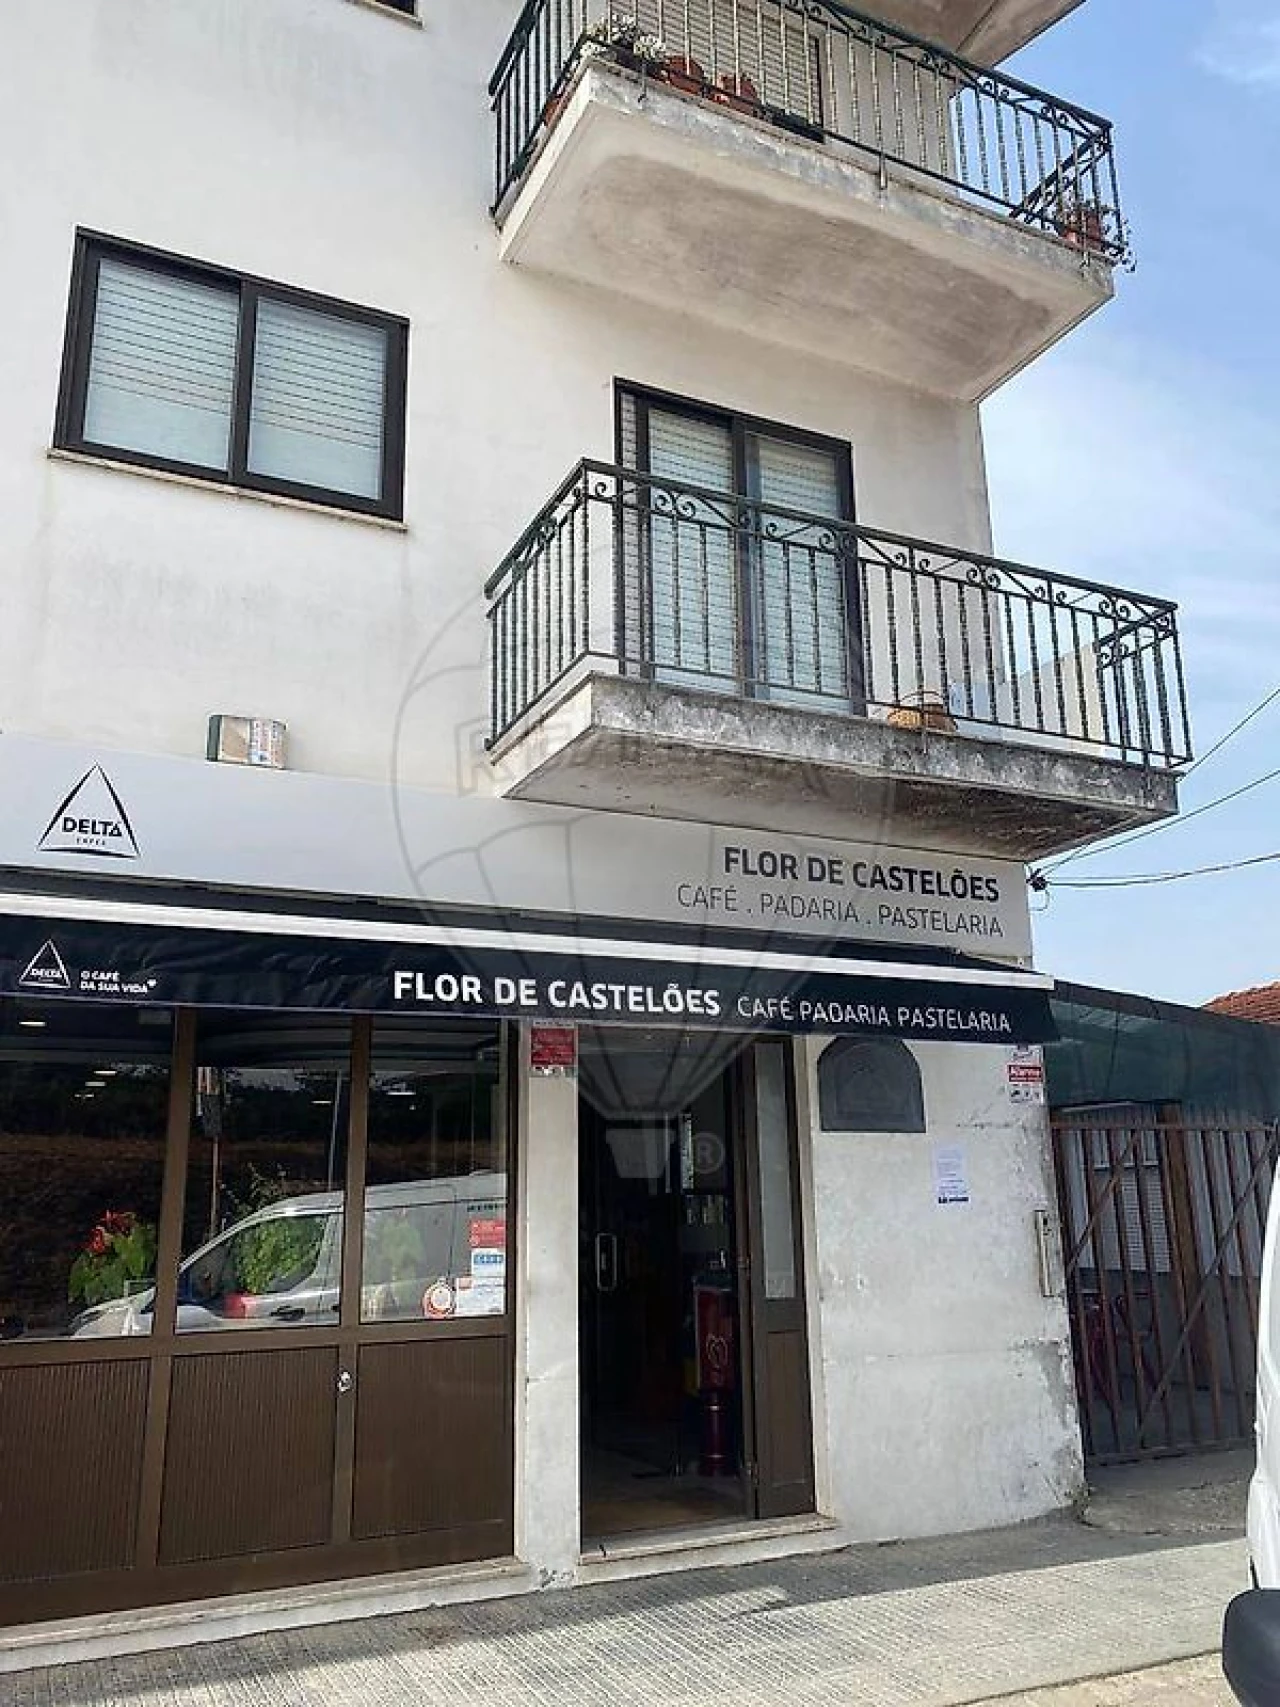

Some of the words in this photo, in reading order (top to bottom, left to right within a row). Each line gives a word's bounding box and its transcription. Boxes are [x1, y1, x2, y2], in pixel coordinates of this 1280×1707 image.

[63, 816, 122, 837] DELTA
[724, 846, 799, 881] FLOR
[807, 856, 844, 885] DE
[852, 862, 1000, 902] CASTELÕES
[677, 882, 738, 912] CAFÉ
[760, 892, 859, 923] PADARIA
[878, 904, 1004, 938] PASTELARIA
[393, 970, 483, 1005] FLOR
[494, 976, 539, 1007] DE
[547, 981, 721, 1017] CASTELÕES
[737, 995, 794, 1022] CAFÉ
[800, 1000, 891, 1027] PADARIA
[898, 1006, 1012, 1034] PASTELARIA
